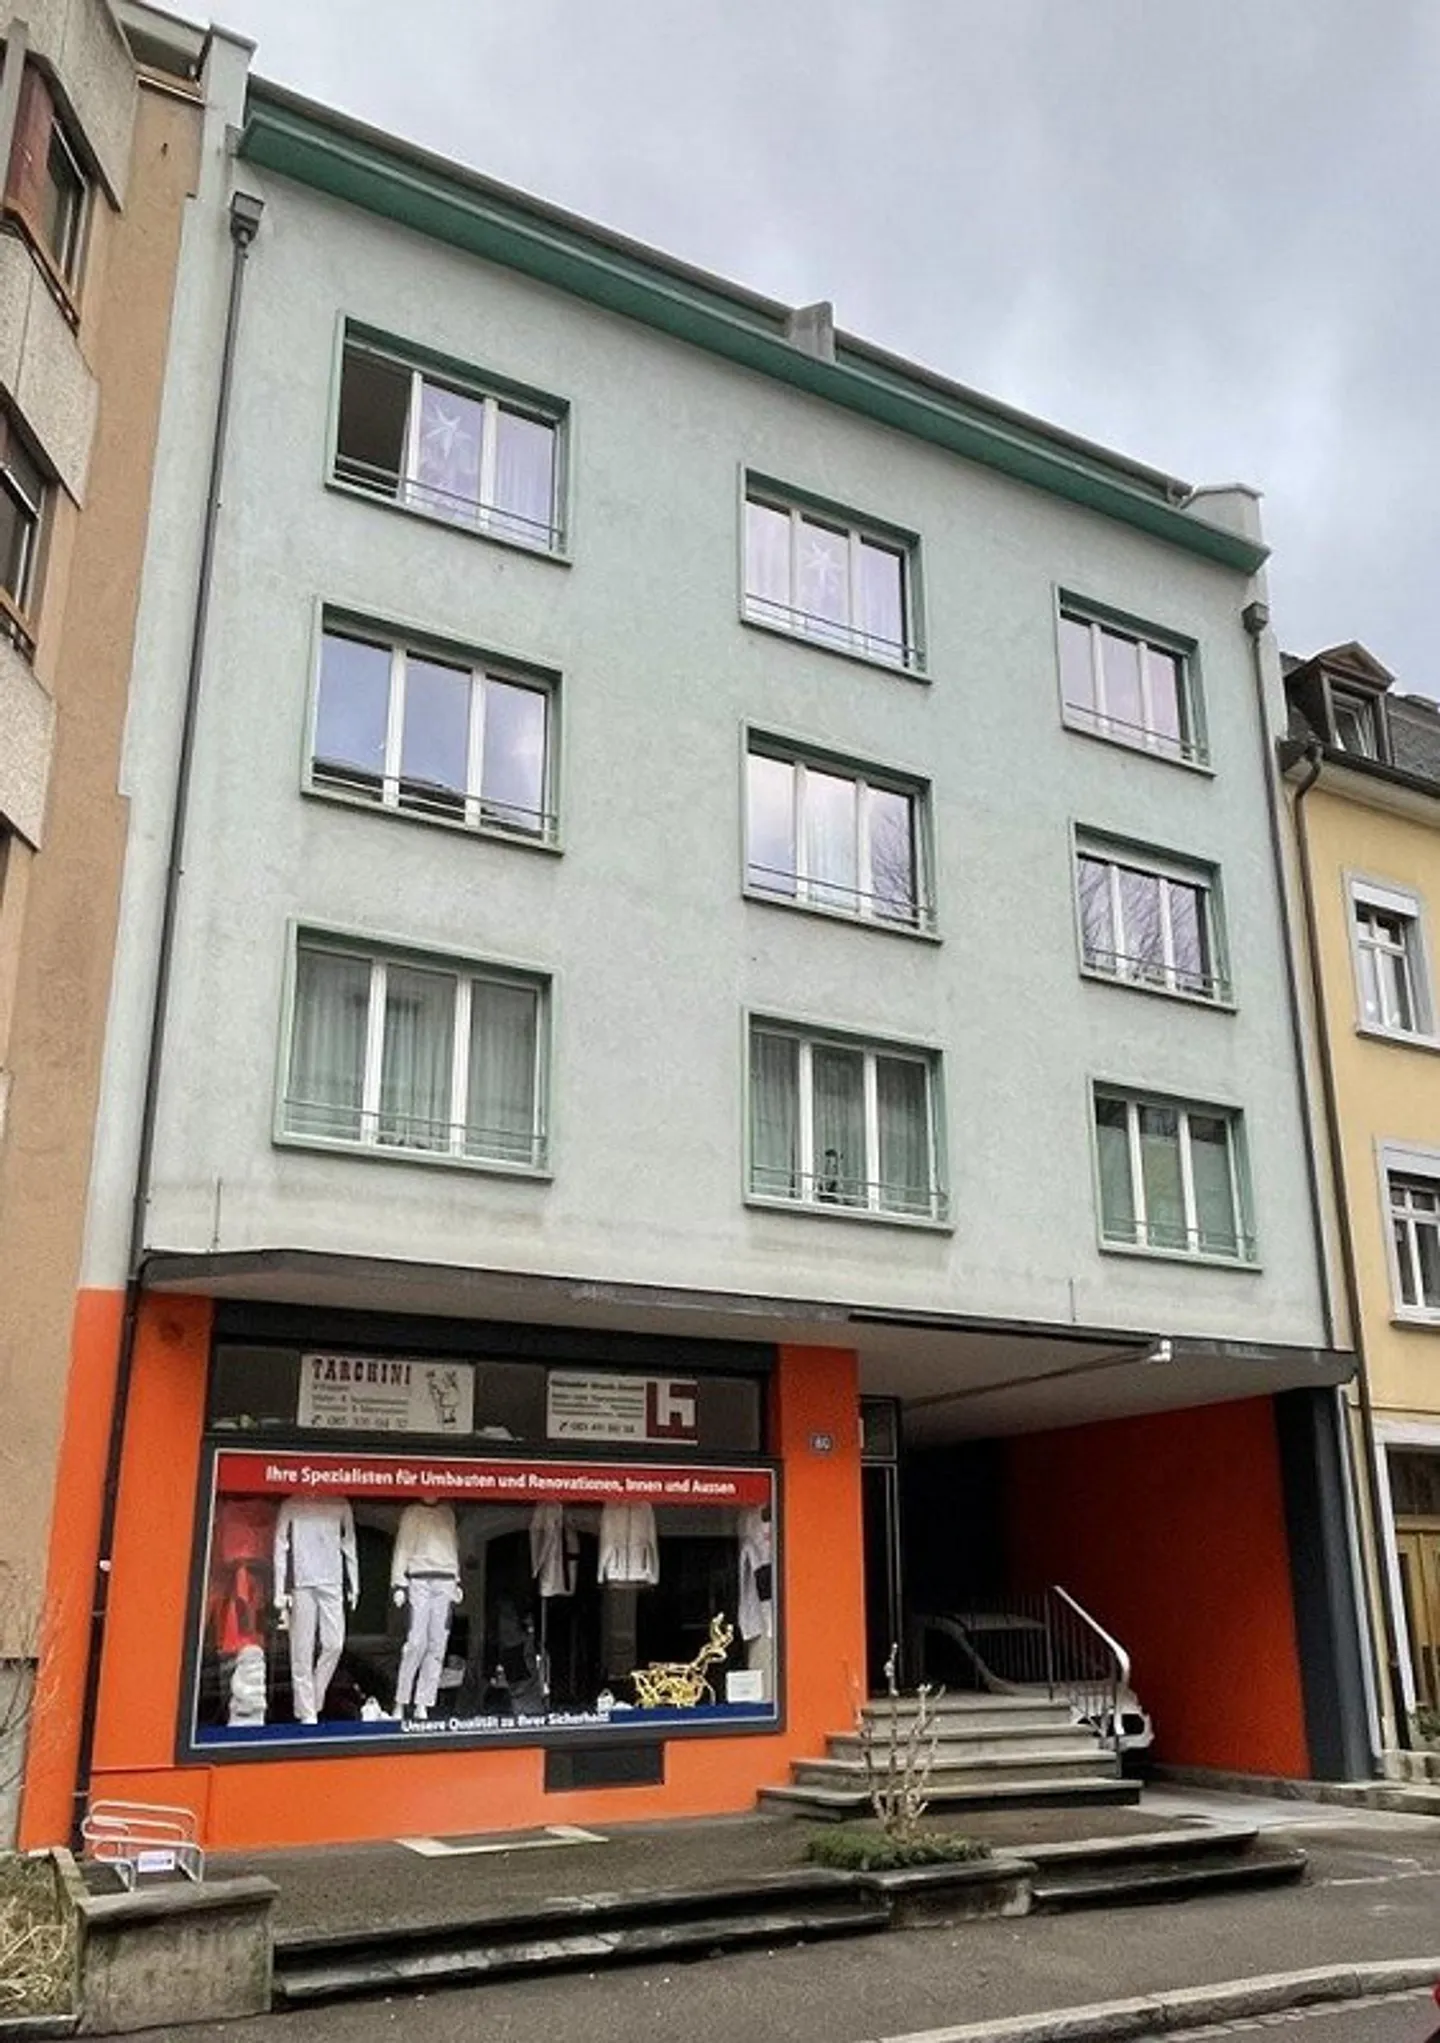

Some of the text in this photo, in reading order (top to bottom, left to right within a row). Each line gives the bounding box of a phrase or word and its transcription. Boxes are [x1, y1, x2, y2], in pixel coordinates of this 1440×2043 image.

[312, 1358, 413, 1385] TARCHINI
[266, 1466, 297, 1482] Ihre
[301, 1466, 395, 1486] Spezialisten
[396, 1469, 417, 1484] für
[421, 1469, 496, 1487] Umbauten
[498, 1474, 526, 1488] und
[528, 1474, 624, 1491] Renovationen,
[665, 1479, 690, 1493] und
[692, 1480, 736, 1494] Aussen
[401, 1719, 446, 1732] Unsere
[450, 1715, 499, 1731] Qualität
